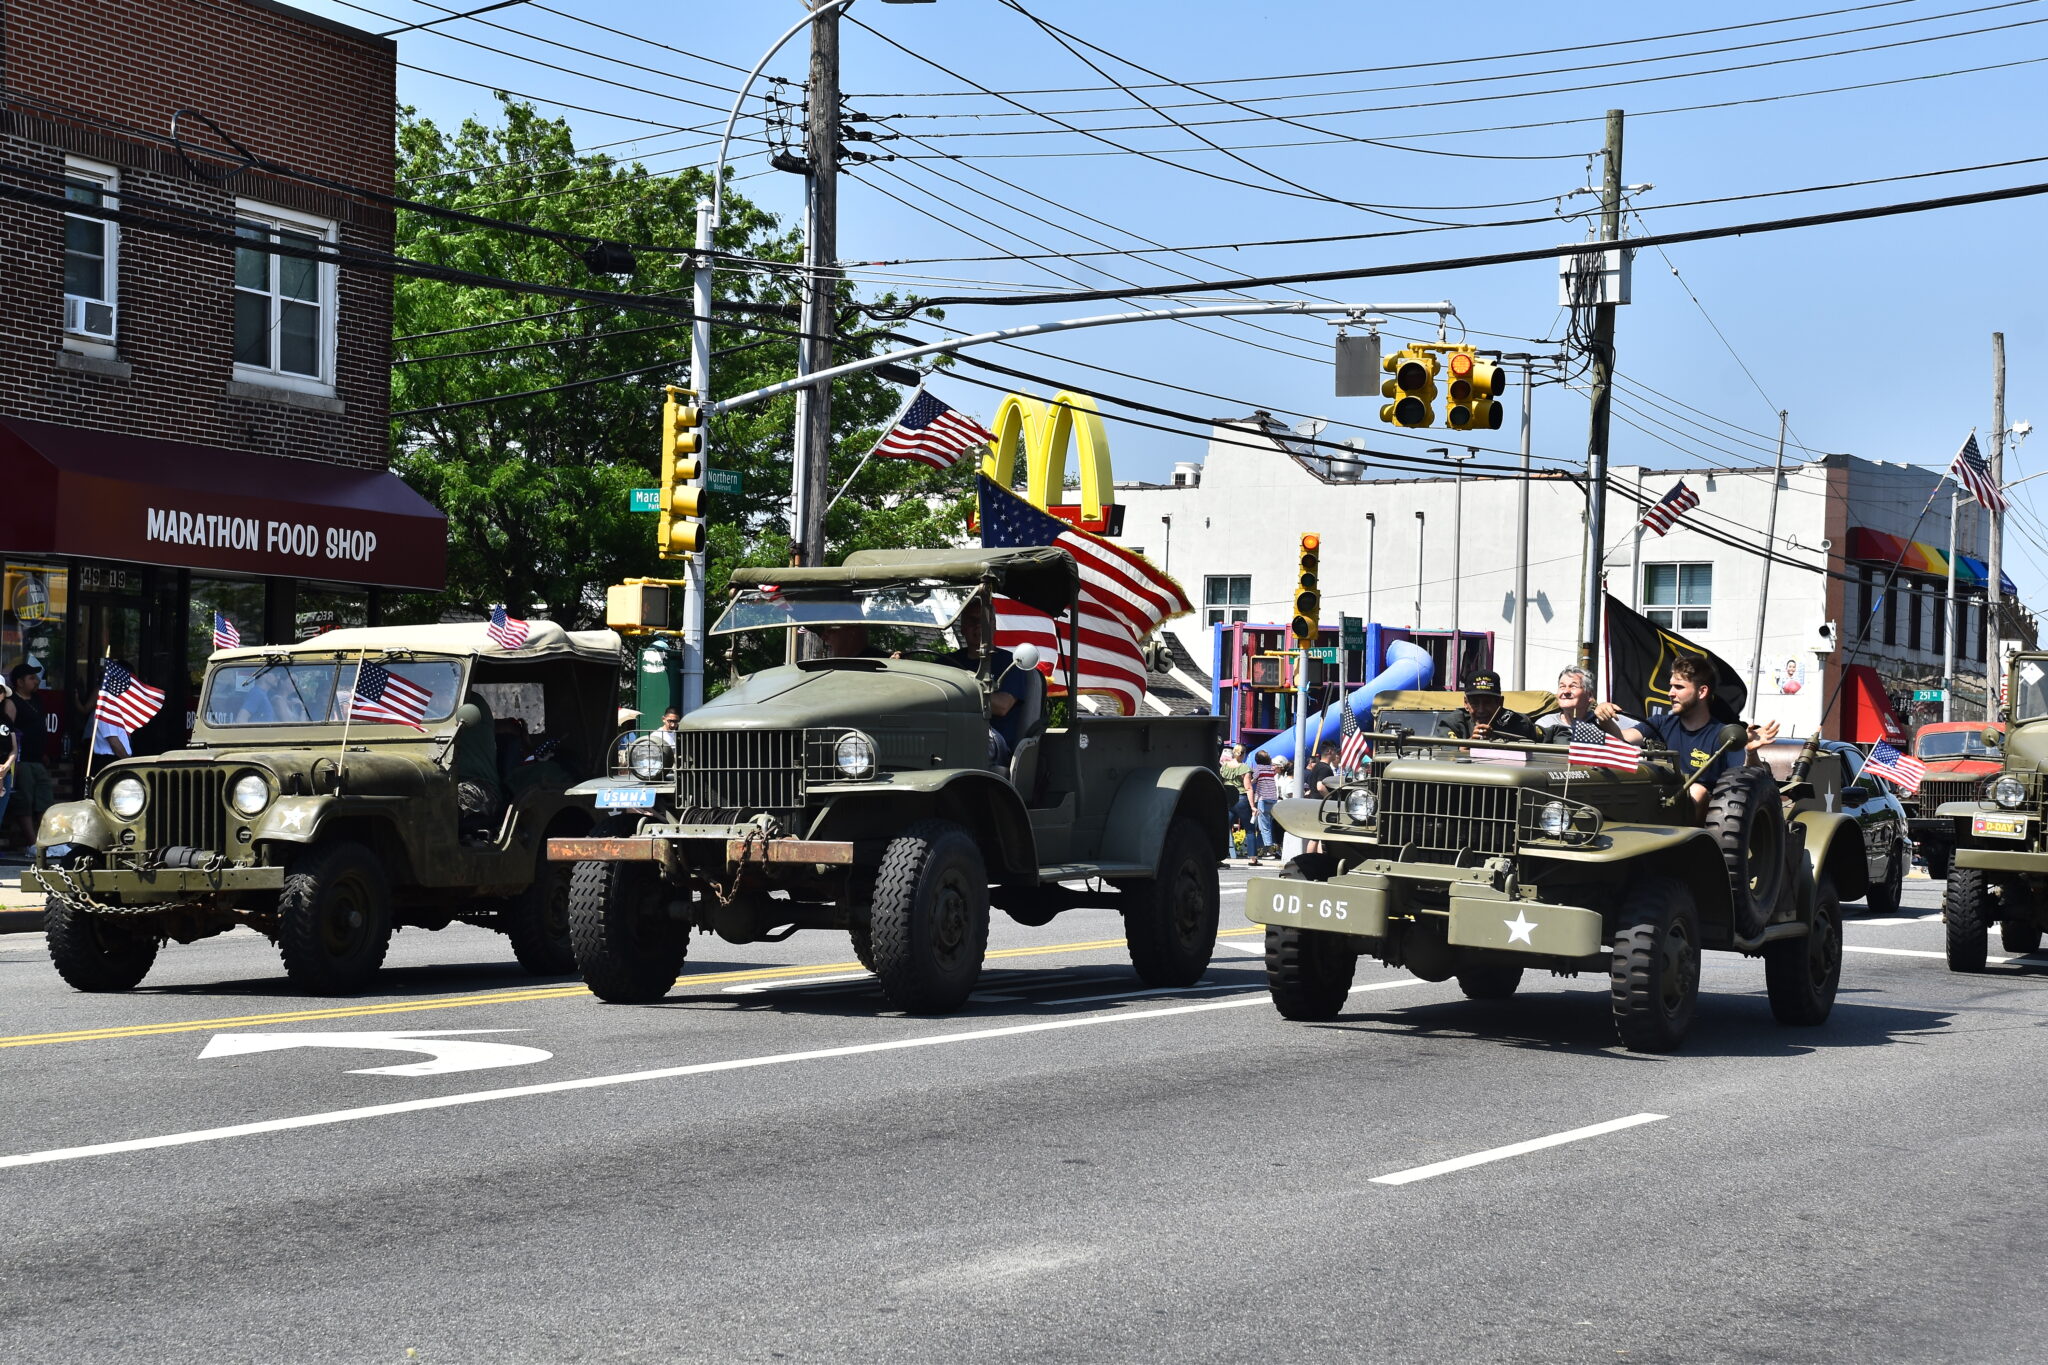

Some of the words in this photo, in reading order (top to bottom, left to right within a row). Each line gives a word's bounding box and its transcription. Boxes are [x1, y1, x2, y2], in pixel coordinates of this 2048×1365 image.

[707, 471, 738, 485] Northern
[636, 491, 660, 503] Mara
[147, 507, 260, 552] MARATHON
[267, 521, 320, 558] FOOD
[325, 527, 377, 562] SHOP
[80, 567, 100, 586] 49
[109, 570, 126, 588] 19
[1919, 691, 1931, 700] 251
[1986, 822, 2013, 832] D-DAY
